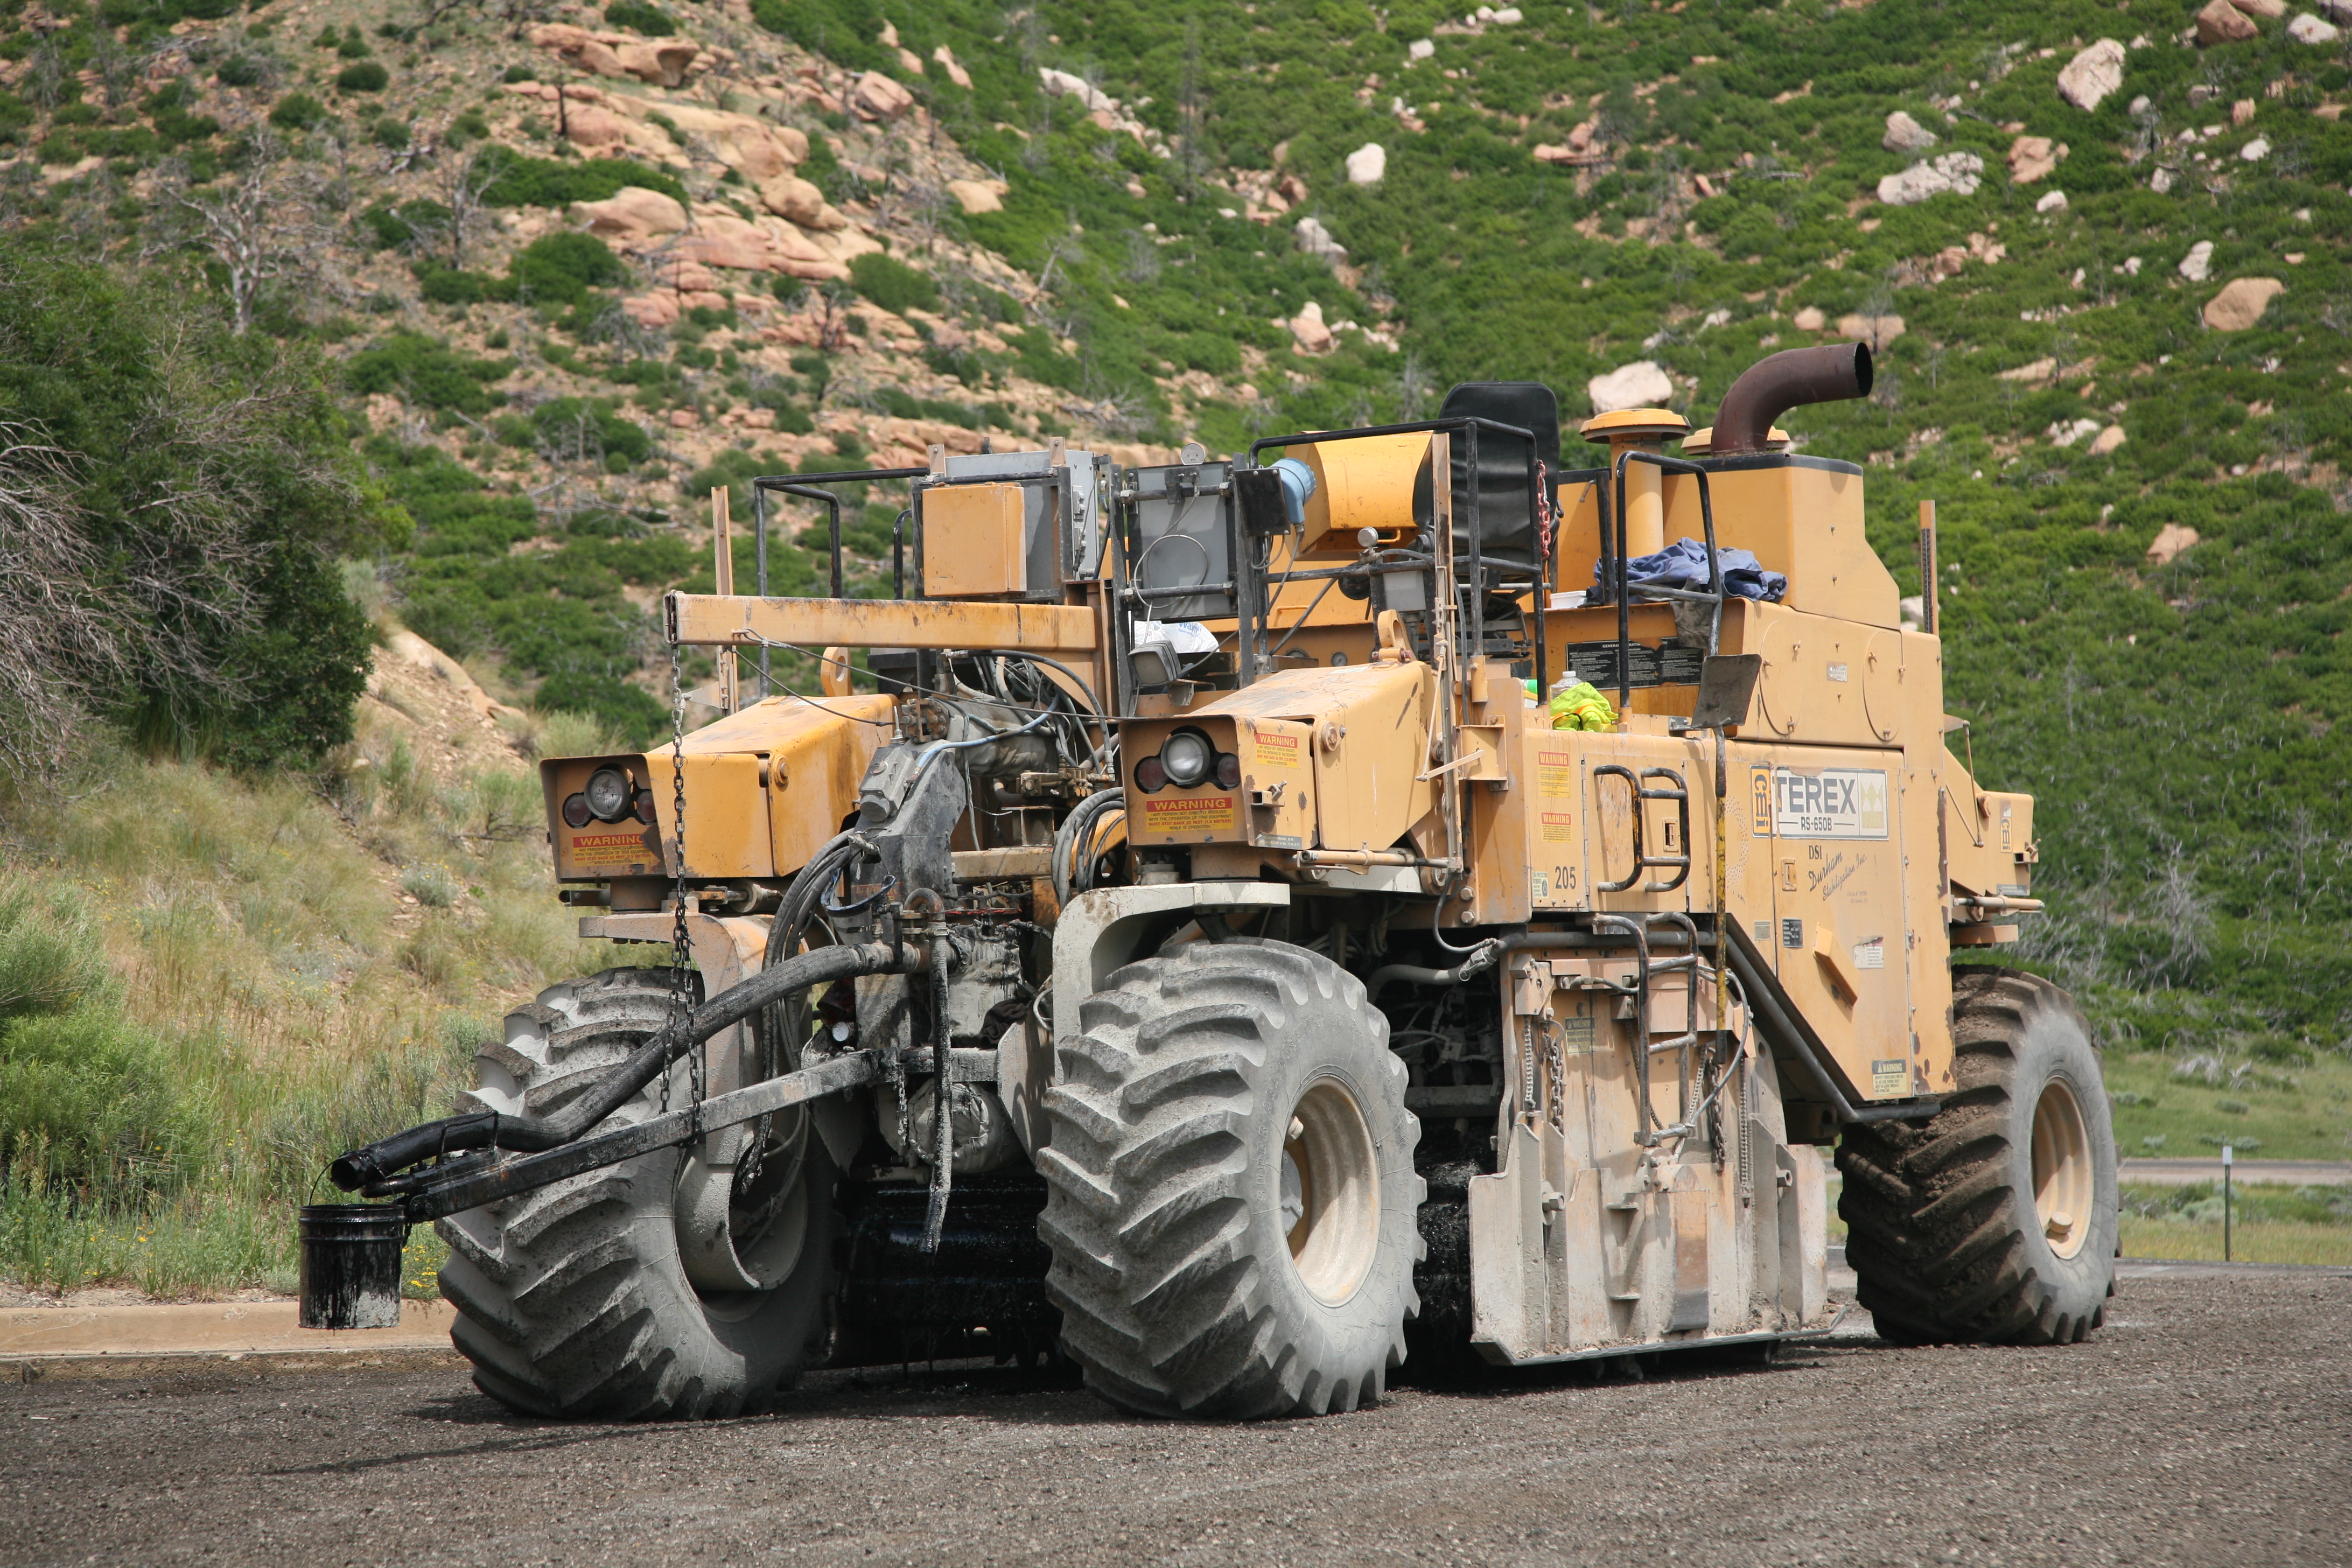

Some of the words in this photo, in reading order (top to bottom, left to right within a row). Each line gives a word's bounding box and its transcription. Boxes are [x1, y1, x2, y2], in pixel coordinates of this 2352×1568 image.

[1259, 734, 1295, 747] WARNING
[1539, 753, 1567, 765] WARNING
[1772, 776, 1857, 814] TEREX
[1154, 799, 1227, 810] WARNING
[1543, 814, 1570, 824] WARNING
[1801, 816, 1832, 831] RS-650B
[1809, 845, 1822, 859] DSI
[1555, 865, 1577, 890] 205
[1808, 851, 1843, 892] Durham
[1823, 864, 1856, 901] Stabilization
